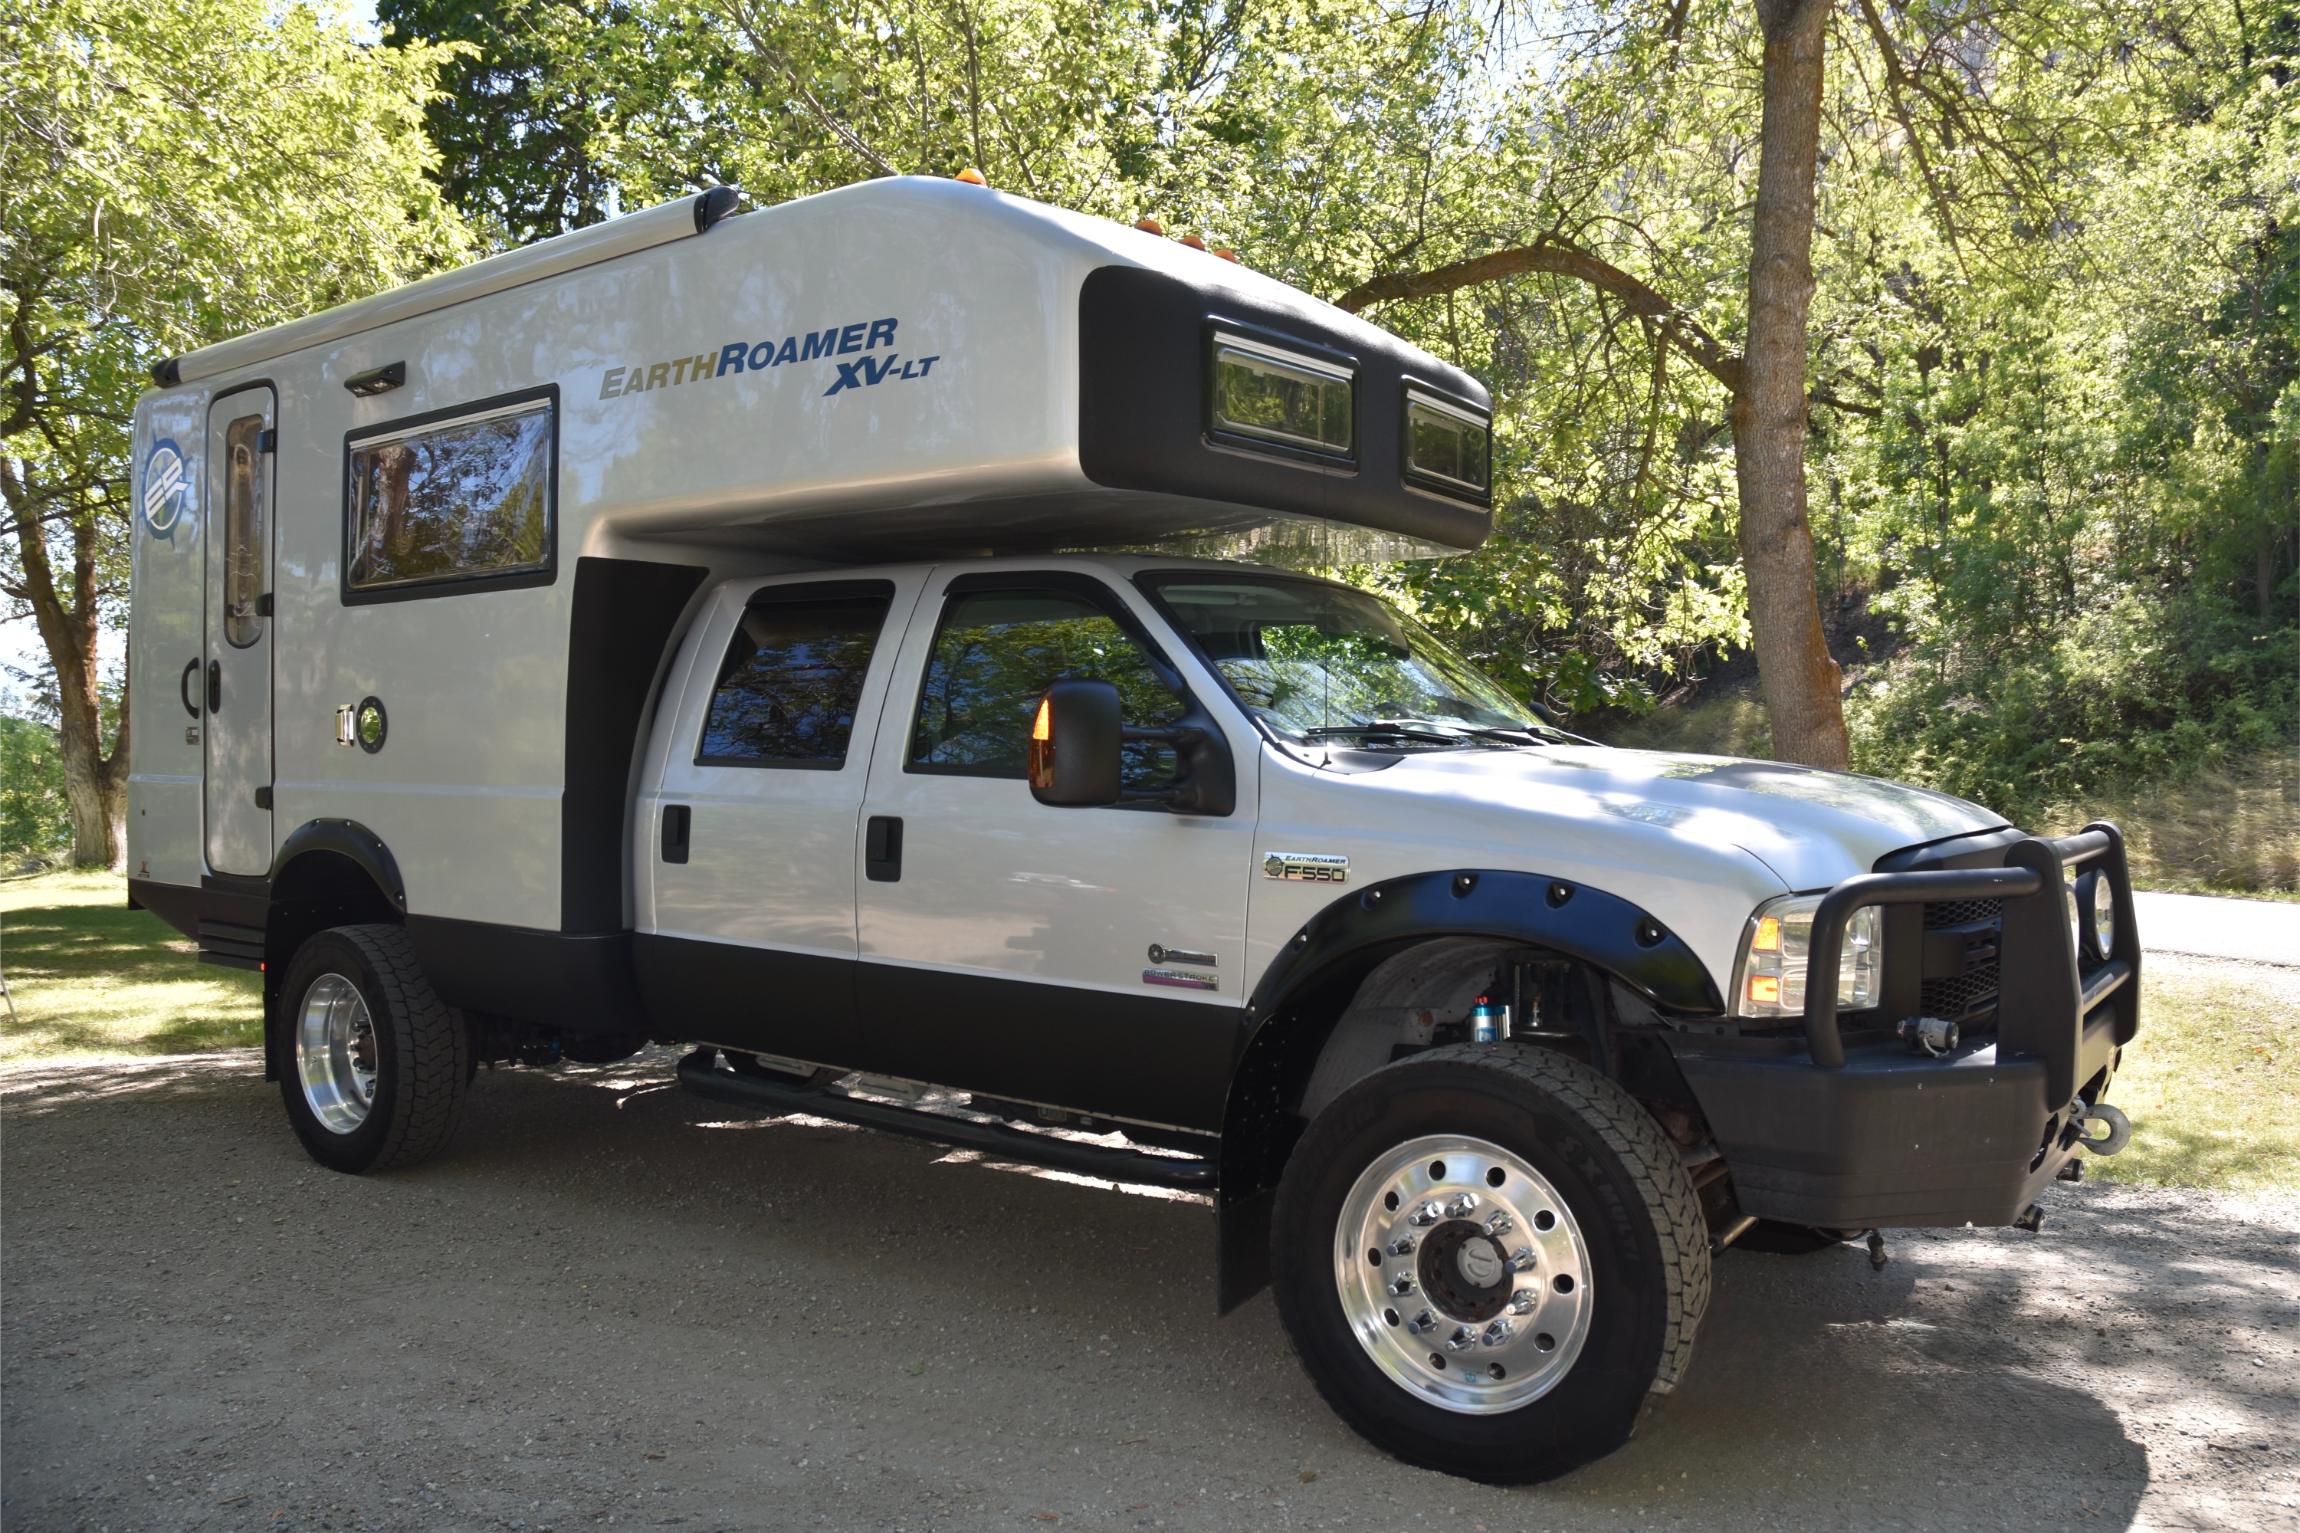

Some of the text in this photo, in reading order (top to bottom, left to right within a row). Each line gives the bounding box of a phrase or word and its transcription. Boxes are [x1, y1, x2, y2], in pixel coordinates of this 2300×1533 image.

[599, 317, 898, 401] EARTHROAMER
[822, 354, 940, 398] XV-LT
[1285, 855, 1346, 864] EARTHROAMER
